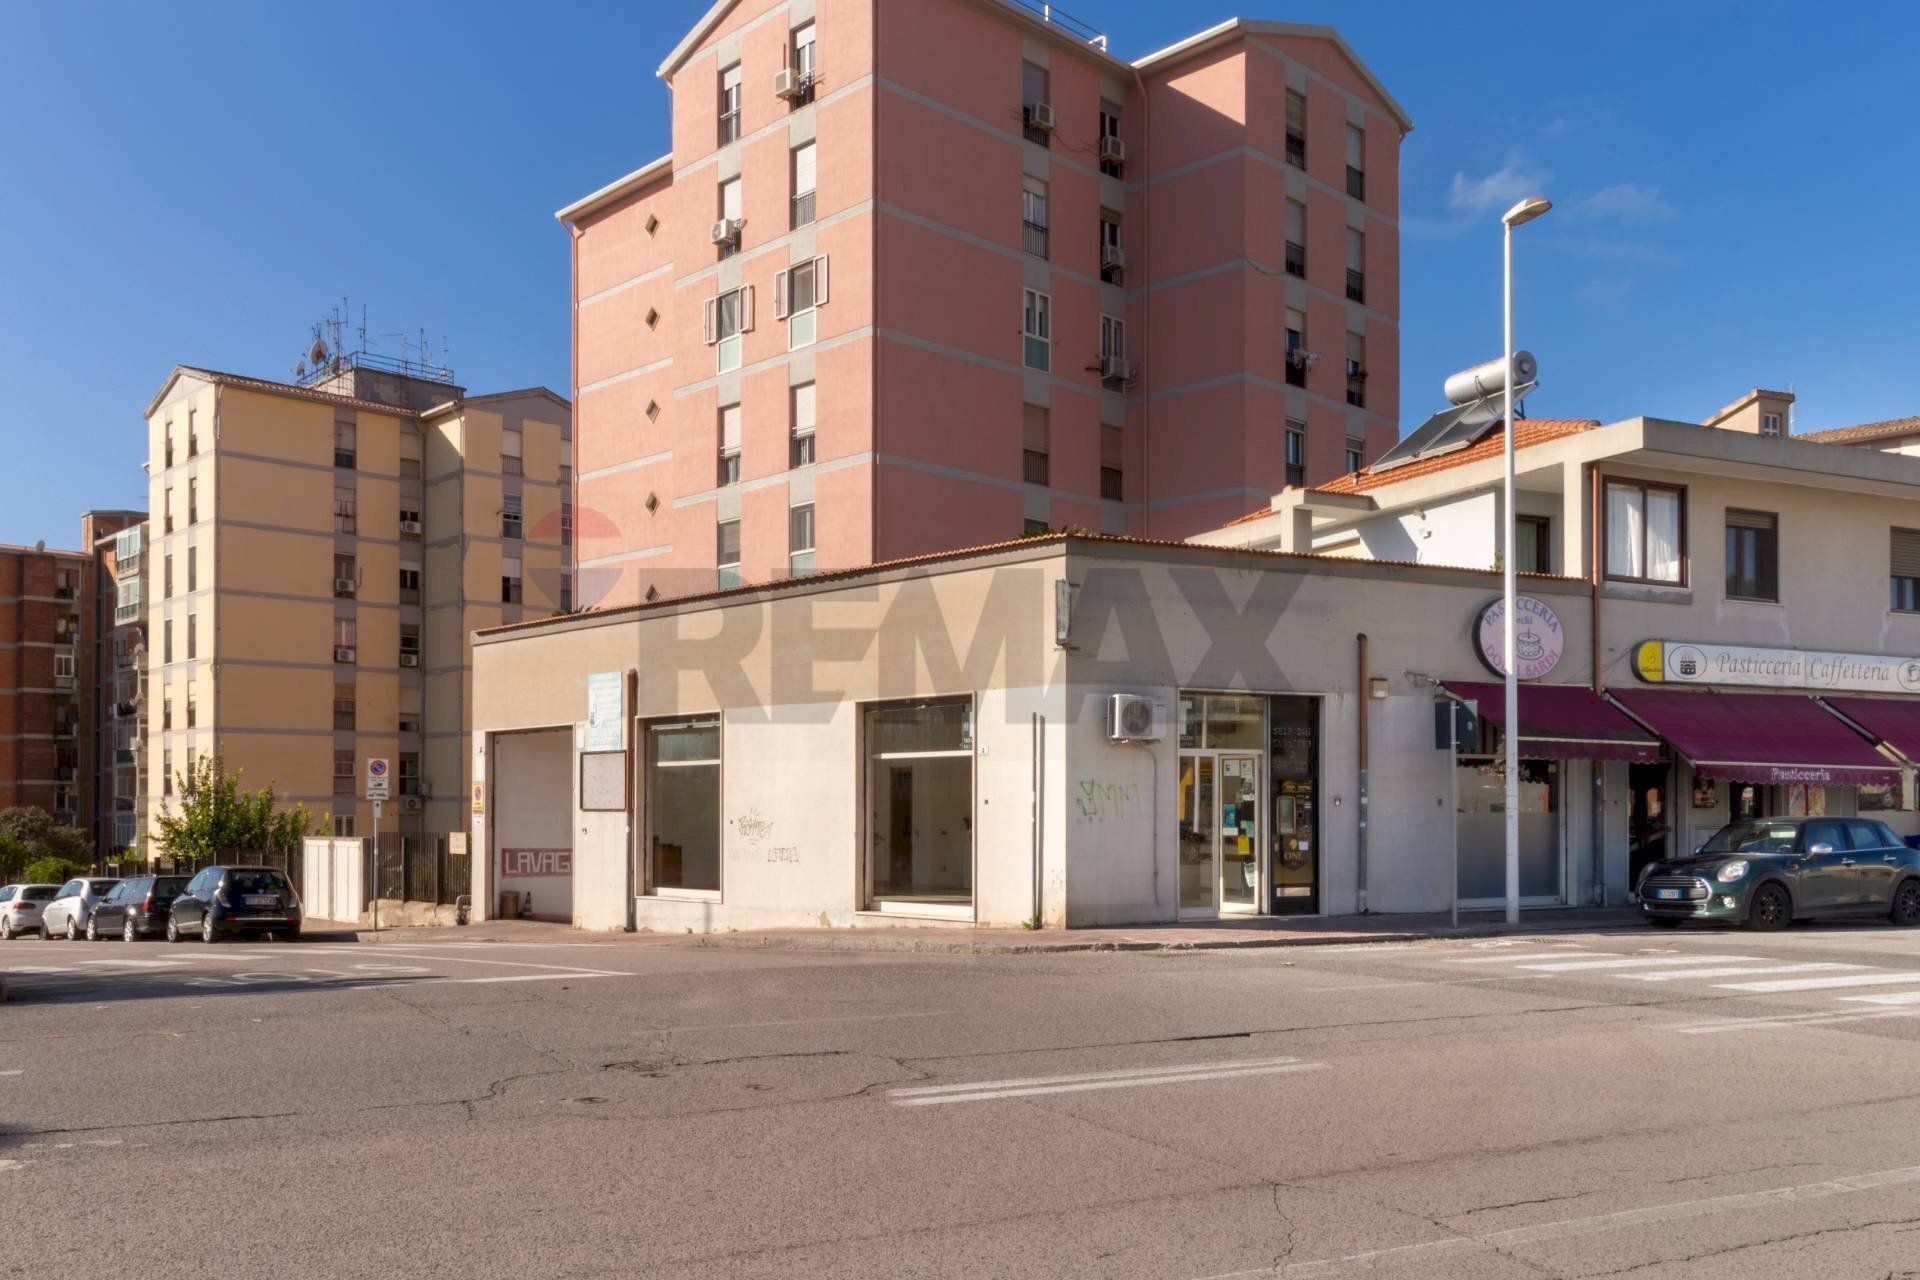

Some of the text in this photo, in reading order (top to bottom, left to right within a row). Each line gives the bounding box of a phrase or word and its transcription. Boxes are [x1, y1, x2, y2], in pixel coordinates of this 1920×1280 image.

[1485, 598, 1558, 633] PASCCERIA
[1526, 649, 1559, 677] SARDI
[1717, 652, 1890, 686] Pasticceria Caffetteria
[1771, 768, 1831, 781] Pasticceria
[505, 851, 574, 873] LAVAG
